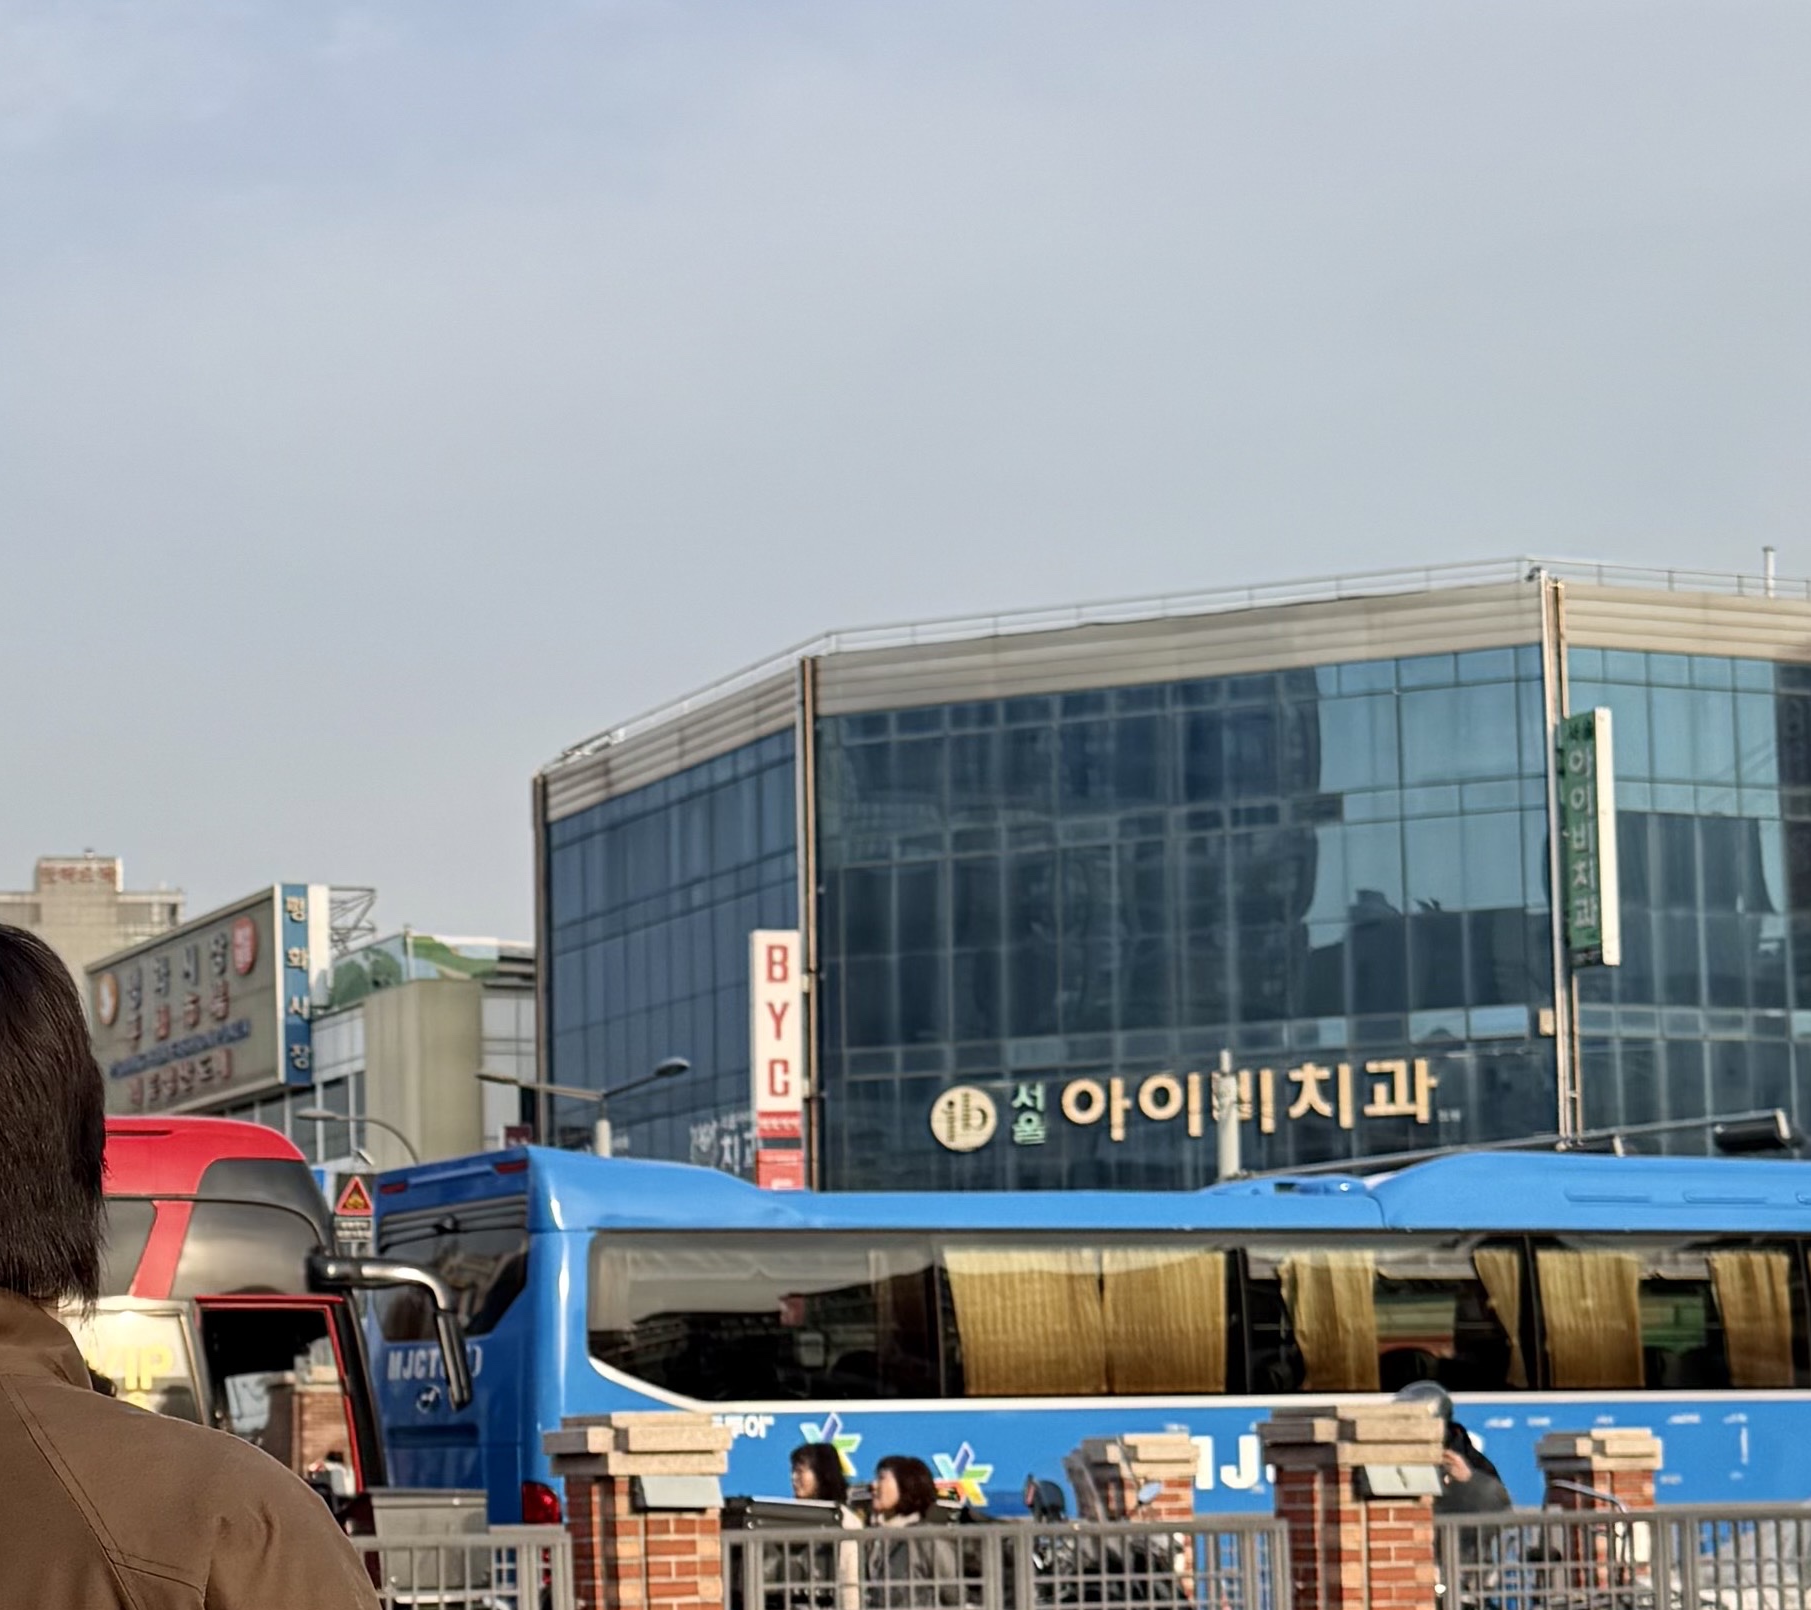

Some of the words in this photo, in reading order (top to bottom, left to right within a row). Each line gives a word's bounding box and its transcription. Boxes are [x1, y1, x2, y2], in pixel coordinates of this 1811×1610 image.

[285, 897, 310, 1070] 평화시장
[766, 943, 791, 1098] BYC
[1011, 1082, 1047, 1146] 서울
